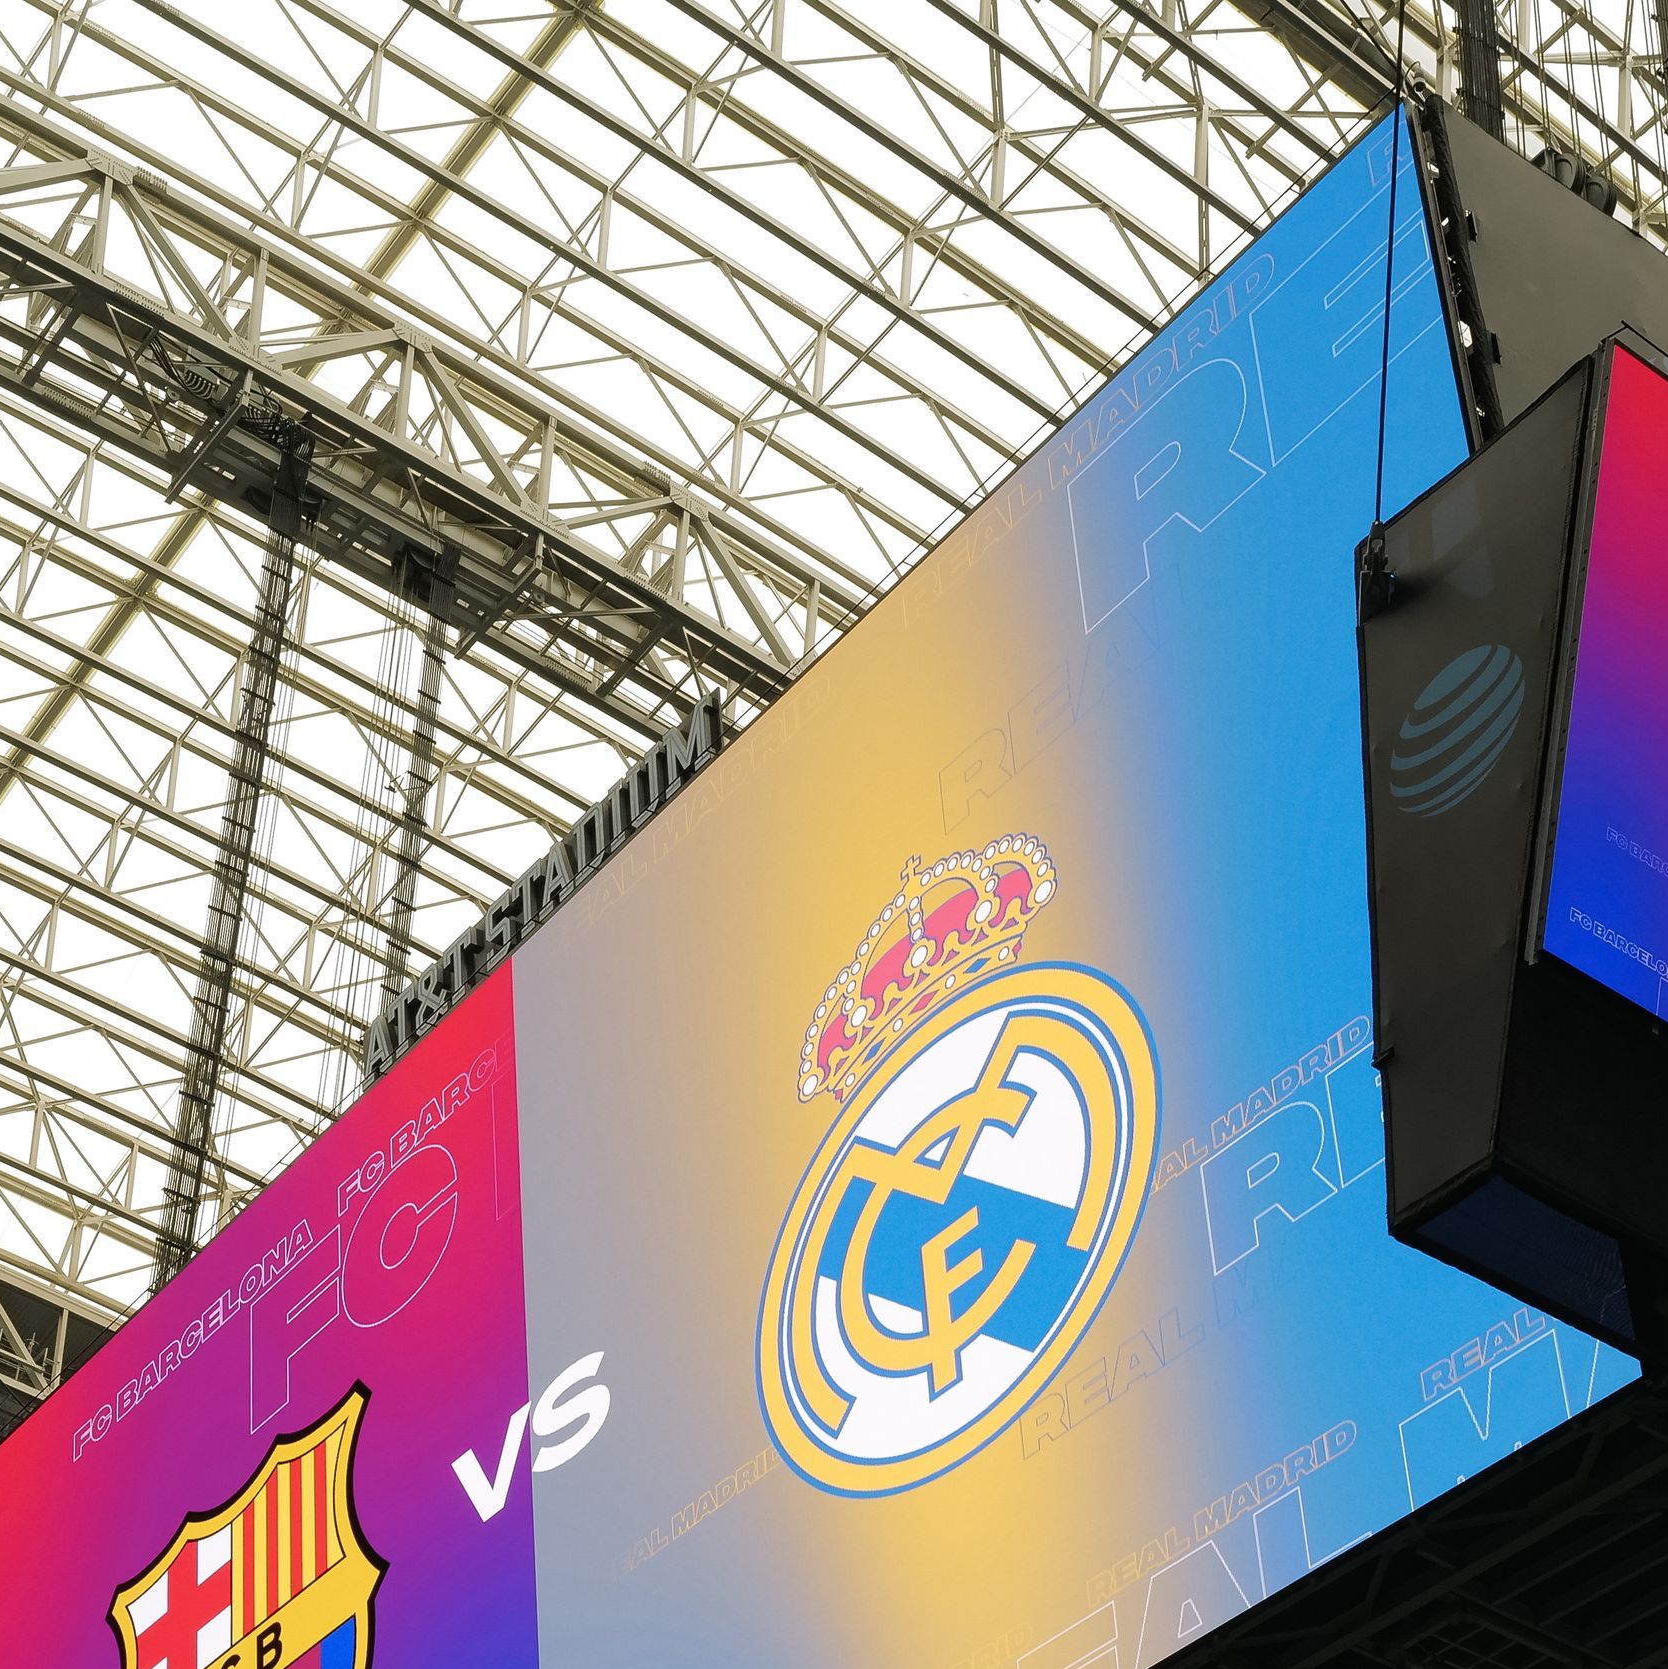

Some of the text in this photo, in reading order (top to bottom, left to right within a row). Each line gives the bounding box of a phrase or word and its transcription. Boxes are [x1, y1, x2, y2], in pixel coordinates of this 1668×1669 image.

[1570, 907, 1592, 930] FC
[1210, 1016, 1370, 1149] MADRID
[72, 1404, 112, 1463] FC
[117, 1218, 313, 1421] BARCELONA
[336, 1148, 386, 1215] FC
[250, 1143, 458, 1435] FC
